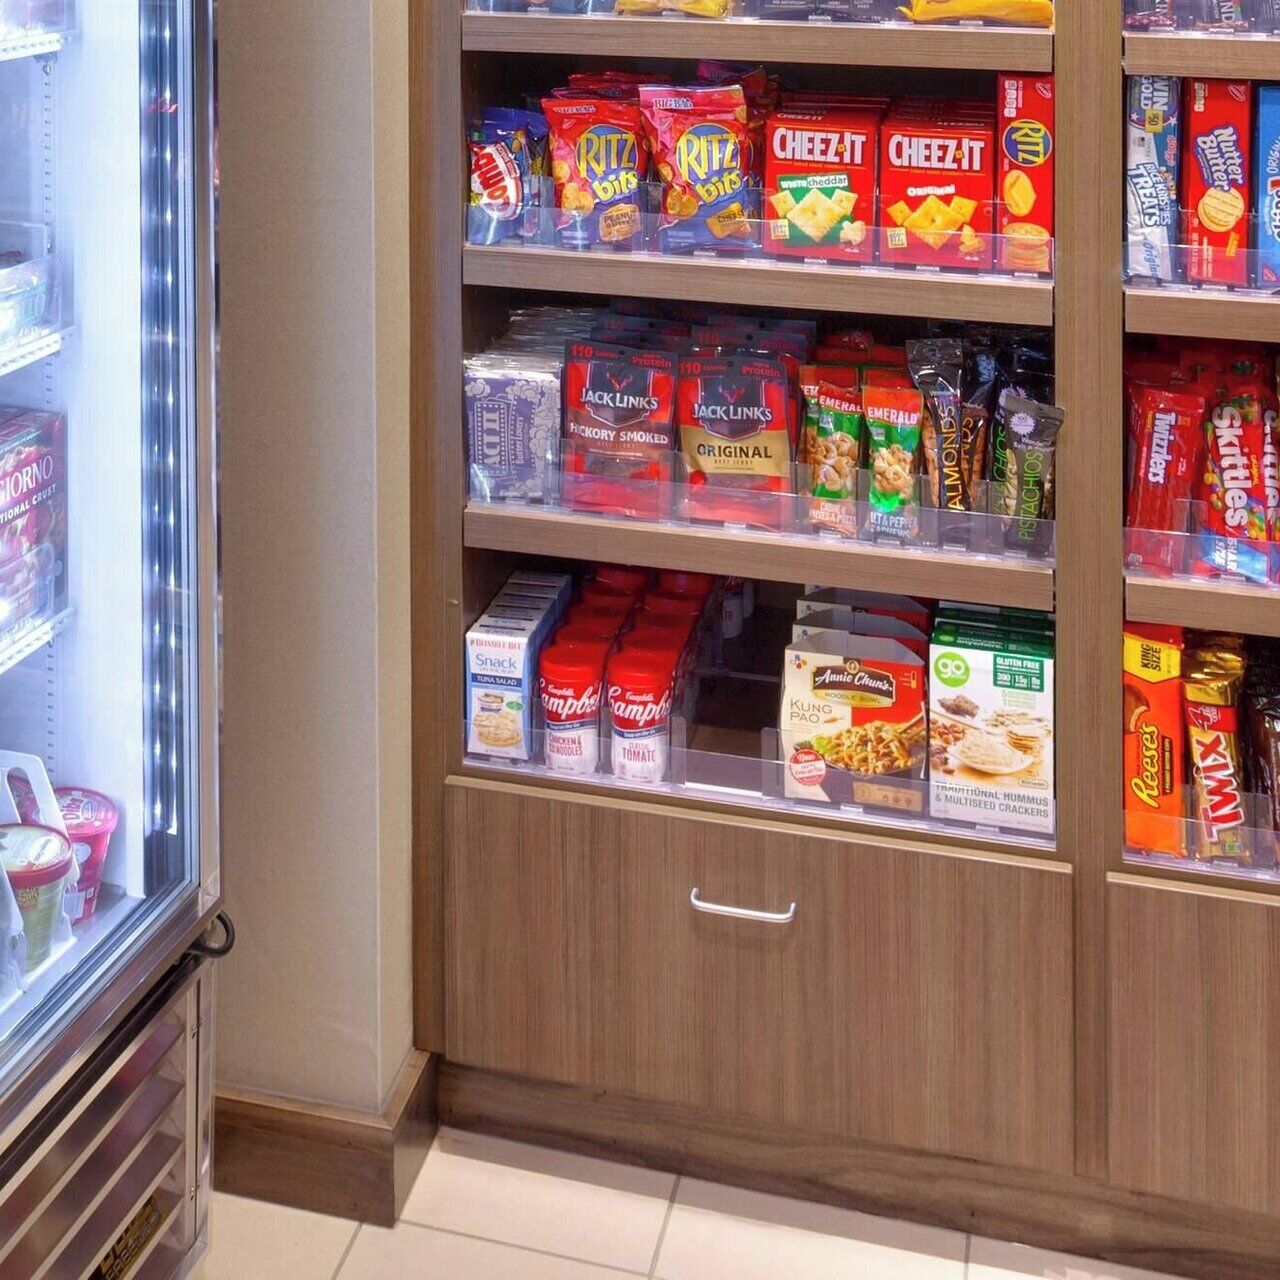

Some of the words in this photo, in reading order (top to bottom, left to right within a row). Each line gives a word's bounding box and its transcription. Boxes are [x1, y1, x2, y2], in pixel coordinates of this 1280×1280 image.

[773, 127, 867, 164] CHEEZ-IT
[889, 134, 985, 170] CHEEZ-IT
[1014, 122, 1045, 163] RITZ
[579, 133, 637, 177] RITZ
[680, 132, 740, 179] RITZ
[1198, 134, 1230, 191] Butter
[1214, 126, 1243, 183] Nutter
[593, 171, 638, 201] bits
[695, 171, 743, 203] bits
[808, 175, 848, 187] cheddar
[1127, 167, 1160, 227] TREATS
[572, 345, 592, 358] 110
[632, 356, 672, 368] Protein
[679, 362, 701, 375] 110
[741, 365, 781, 377] Protein
[580, 388, 615, 408] JACK
[693, 403, 727, 420] JACK
[868, 406, 919, 424] EMERALD
[570, 422, 616, 442] HICKORY
[620, 431, 669, 445] SMOKED
[697, 443, 772, 459] ORIGINAL
[940, 405, 964, 511] ALMONDS
[1149, 412, 1176, 484] Twizzlers
[1212, 406, 1252, 528] Skittles
[32, 483, 57, 506] CRUST
[1018, 451, 1043, 541] PISTACHIOS
[475, 653, 517, 669] Snack
[938, 658, 965, 677] go
[996, 658, 1022, 667] GLUTEN
[1023, 660, 1040, 670] FREE
[1140, 644, 1151, 670] KING
[1151, 647, 1162, 672] SIZE
[495, 677, 517, 685] SALAD
[815, 669, 853, 686] Annie
[855, 672, 892, 691] Chun's
[791, 698, 833, 714] KUNG
[790, 712, 820, 724] PAO
[1130, 722, 1160, 809] Reese's
[935, 785, 1000, 800] TRADITIONAL
[1003, 792, 1049, 807] HUMMUS
[935, 794, 942, 802] &
[944, 794, 996, 811] MULTISEED
[999, 804, 1049, 818] CRACKERS
